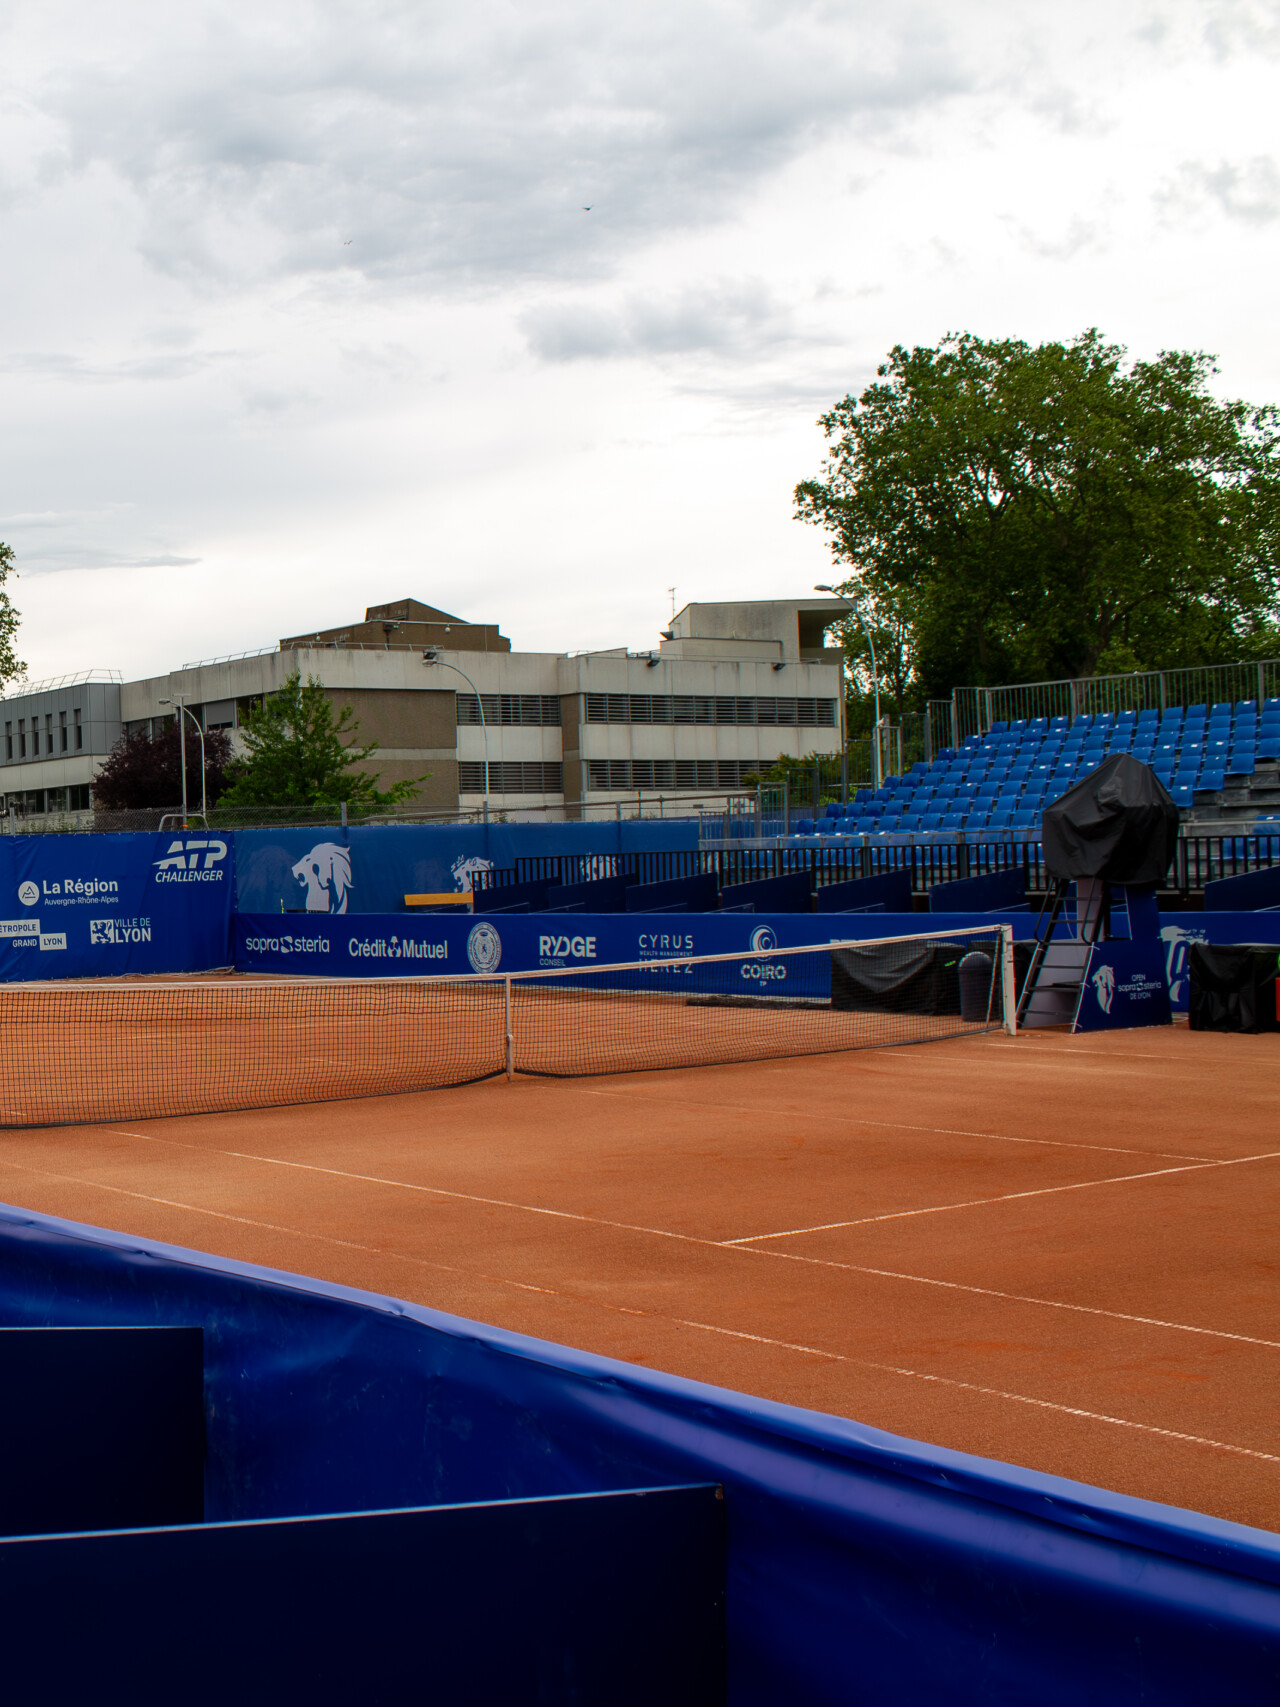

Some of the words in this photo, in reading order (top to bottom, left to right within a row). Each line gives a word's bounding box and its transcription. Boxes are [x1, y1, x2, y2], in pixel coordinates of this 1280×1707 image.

[152, 840, 228, 870] ATP
[155, 870, 224, 884] CHALLENGER
[43, 880, 61, 894] La
[64, 878, 119, 896] Région
[44, 895, 119, 907] Auvergne-Rhône-Alpes
[114, 918, 138, 928] VILLE
[139, 917, 151, 927] DE
[12, 939, 38, 948] GRAND
[43, 937, 63, 946] LYON
[115, 927, 152, 944] LYON
[638, 934, 694, 949] CYRUS
[245, 937, 279, 954] sopra
[294, 935, 330, 953] steria
[348, 938, 387, 958] Crédit
[402, 939, 448, 959] Mutuel
[539, 935, 597, 958] RYDGE
[740, 964, 788, 980] COIRO
